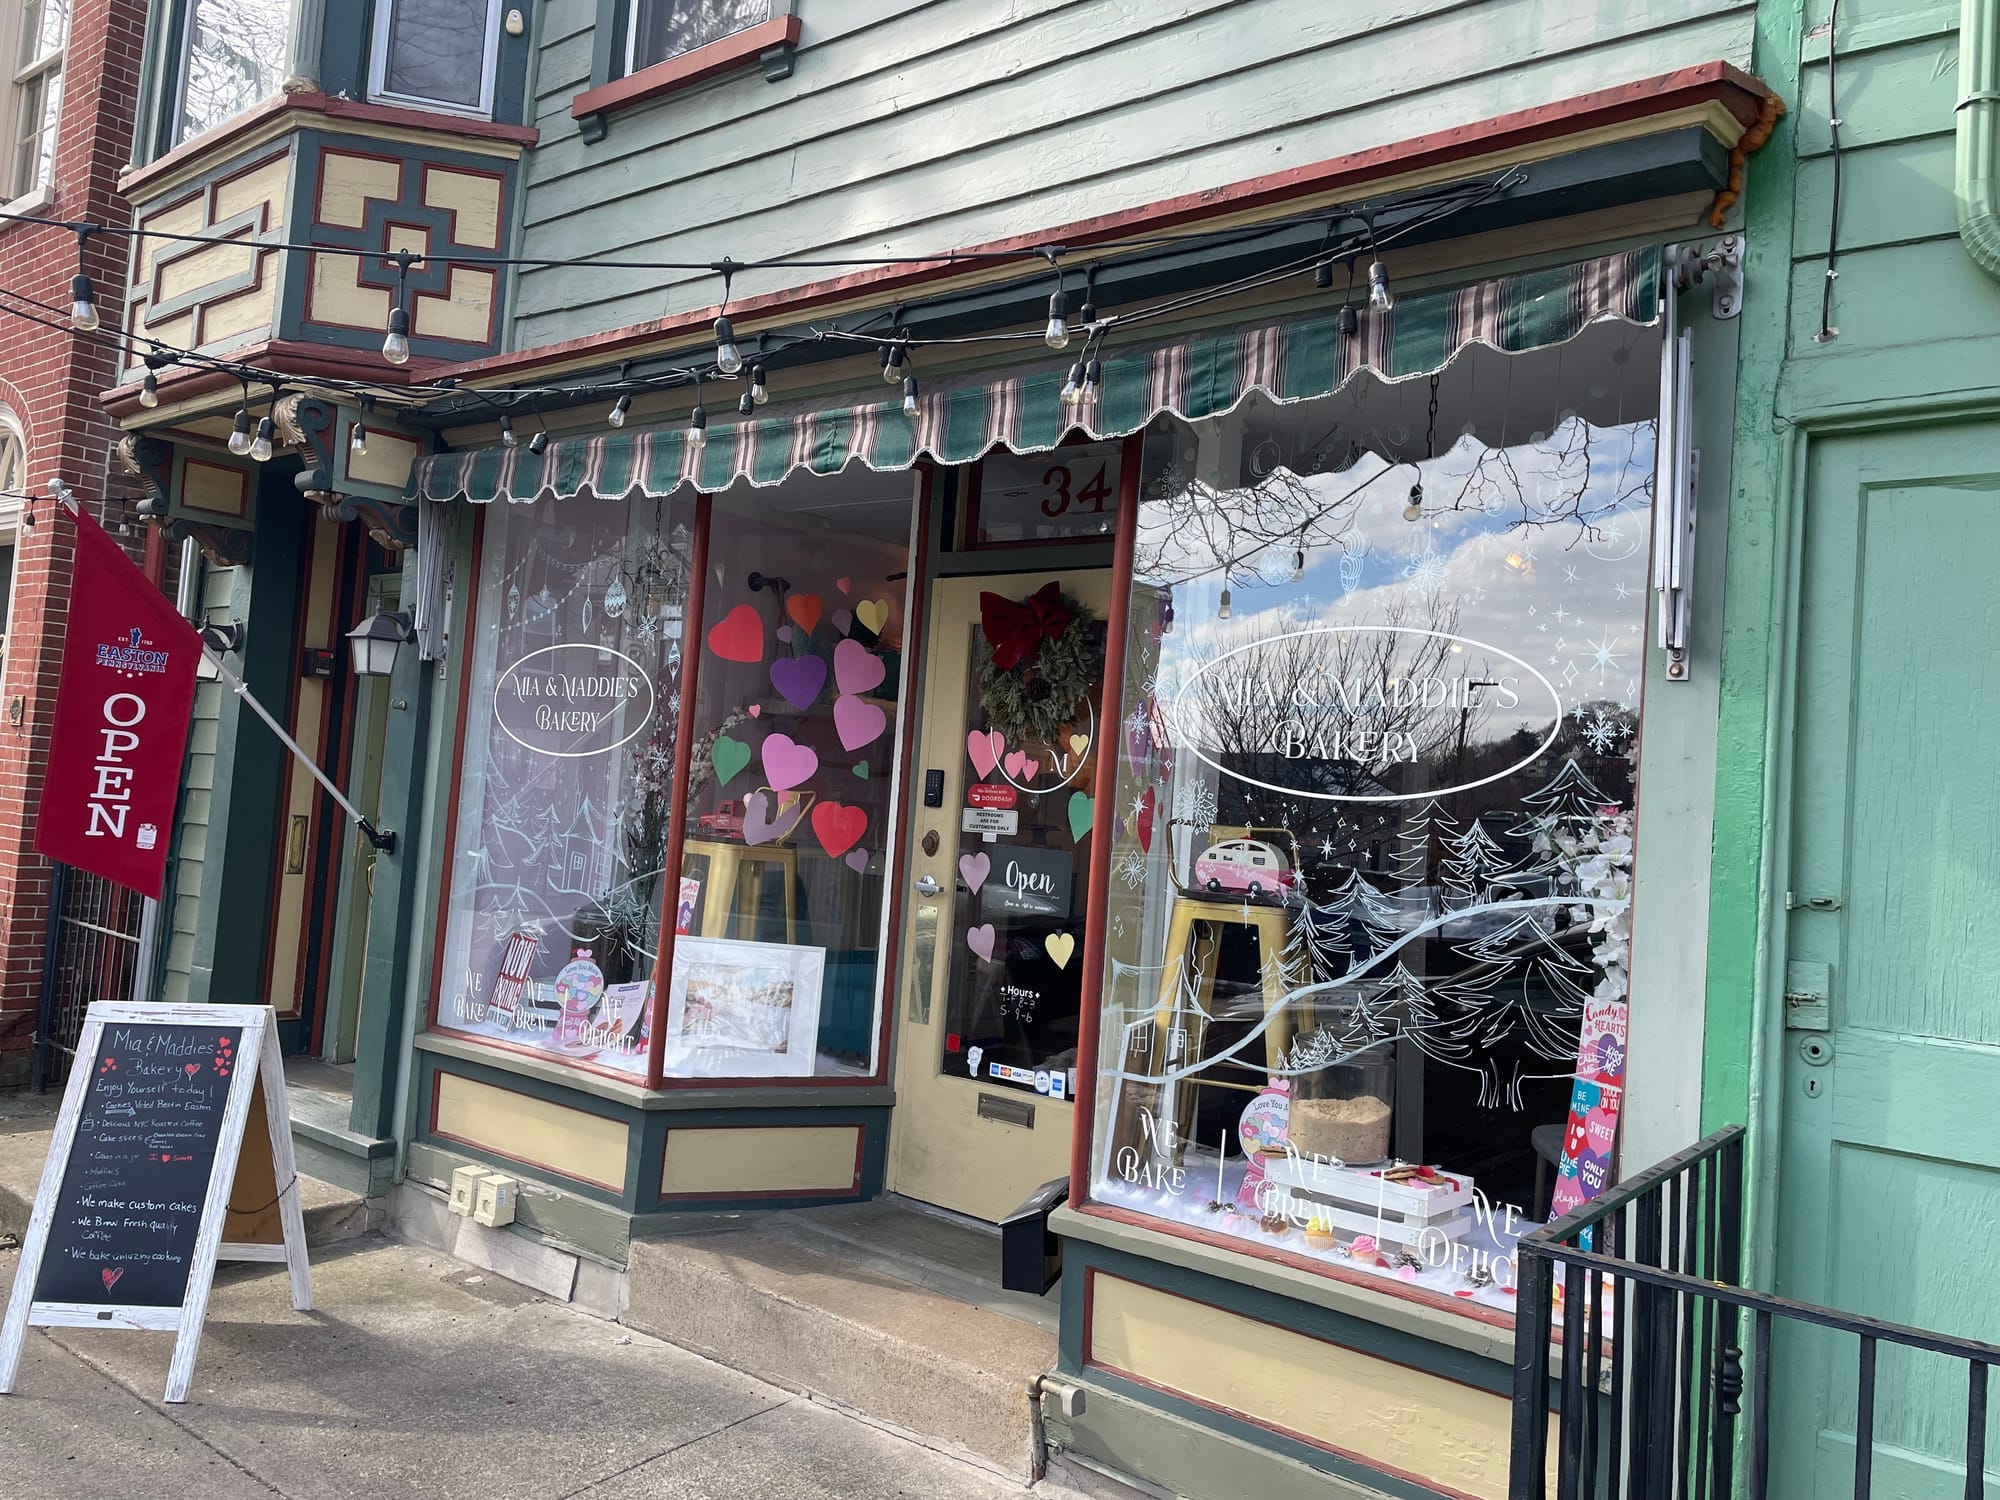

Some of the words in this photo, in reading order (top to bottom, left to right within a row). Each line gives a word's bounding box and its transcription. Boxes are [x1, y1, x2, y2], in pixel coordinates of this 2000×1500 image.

[1041, 459, 1112, 517] 34
[96, 643, 169, 666] EASTON
[96, 658, 166, 673] PENNSYLVANIA
[545, 676, 558, 697] &
[1292, 678, 1319, 707] &
[535, 704, 600, 733] BAKERY
[1271, 719, 1427, 763] BAKERY
[85, 693, 146, 838] OPEN
[1006, 860, 1055, 900] Open
[501, 936, 536, 979] NOW
[1007, 985, 1033, 998] Hours
[454, 993, 484, 1023] BAKE
[1586, 1002, 1617, 1022] Candy
[1594, 1019, 1626, 1038] HEARTS
[113, 1029, 142, 1053] Mia
[1605, 1044, 1625, 1066] KISS
[126, 1057, 182, 1083] Bakery
[1603, 1061, 1617, 1077] ME
[96, 1078, 123, 1098] Enjoy
[1577, 1090, 1588, 1101] BE
[184, 1102, 211, 1111] Easton
[1252, 1100, 1269, 1111] Love
[1269, 1099, 1283, 1110] You
[1571, 1102, 1590, 1114] MINE
[1600, 1097, 1609, 1109] ON
[1139, 1106, 1179, 1158] WE
[1570, 1123, 1575, 1135] I
[1589, 1121, 1615, 1142] SWEET
[1570, 1138, 1577, 1151] U
[1117, 1145, 1186, 1196] BAKE
[1584, 1160, 1605, 1177] ONLY
[1582, 1170, 1602, 1189] YOU
[81, 1194, 95, 1207] We
[98, 1198, 126, 1209] make
[128, 1200, 166, 1210] custom
[1254, 1178, 1336, 1235] BREW
[78, 1216, 92, 1226] We
[123, 1218, 147, 1228] Fresh
[1471, 1186, 1524, 1249] WE
[71, 1246, 87, 1260] We
[89, 1249, 111, 1260] bake
[1418, 1226, 1517, 1288] DELIG
